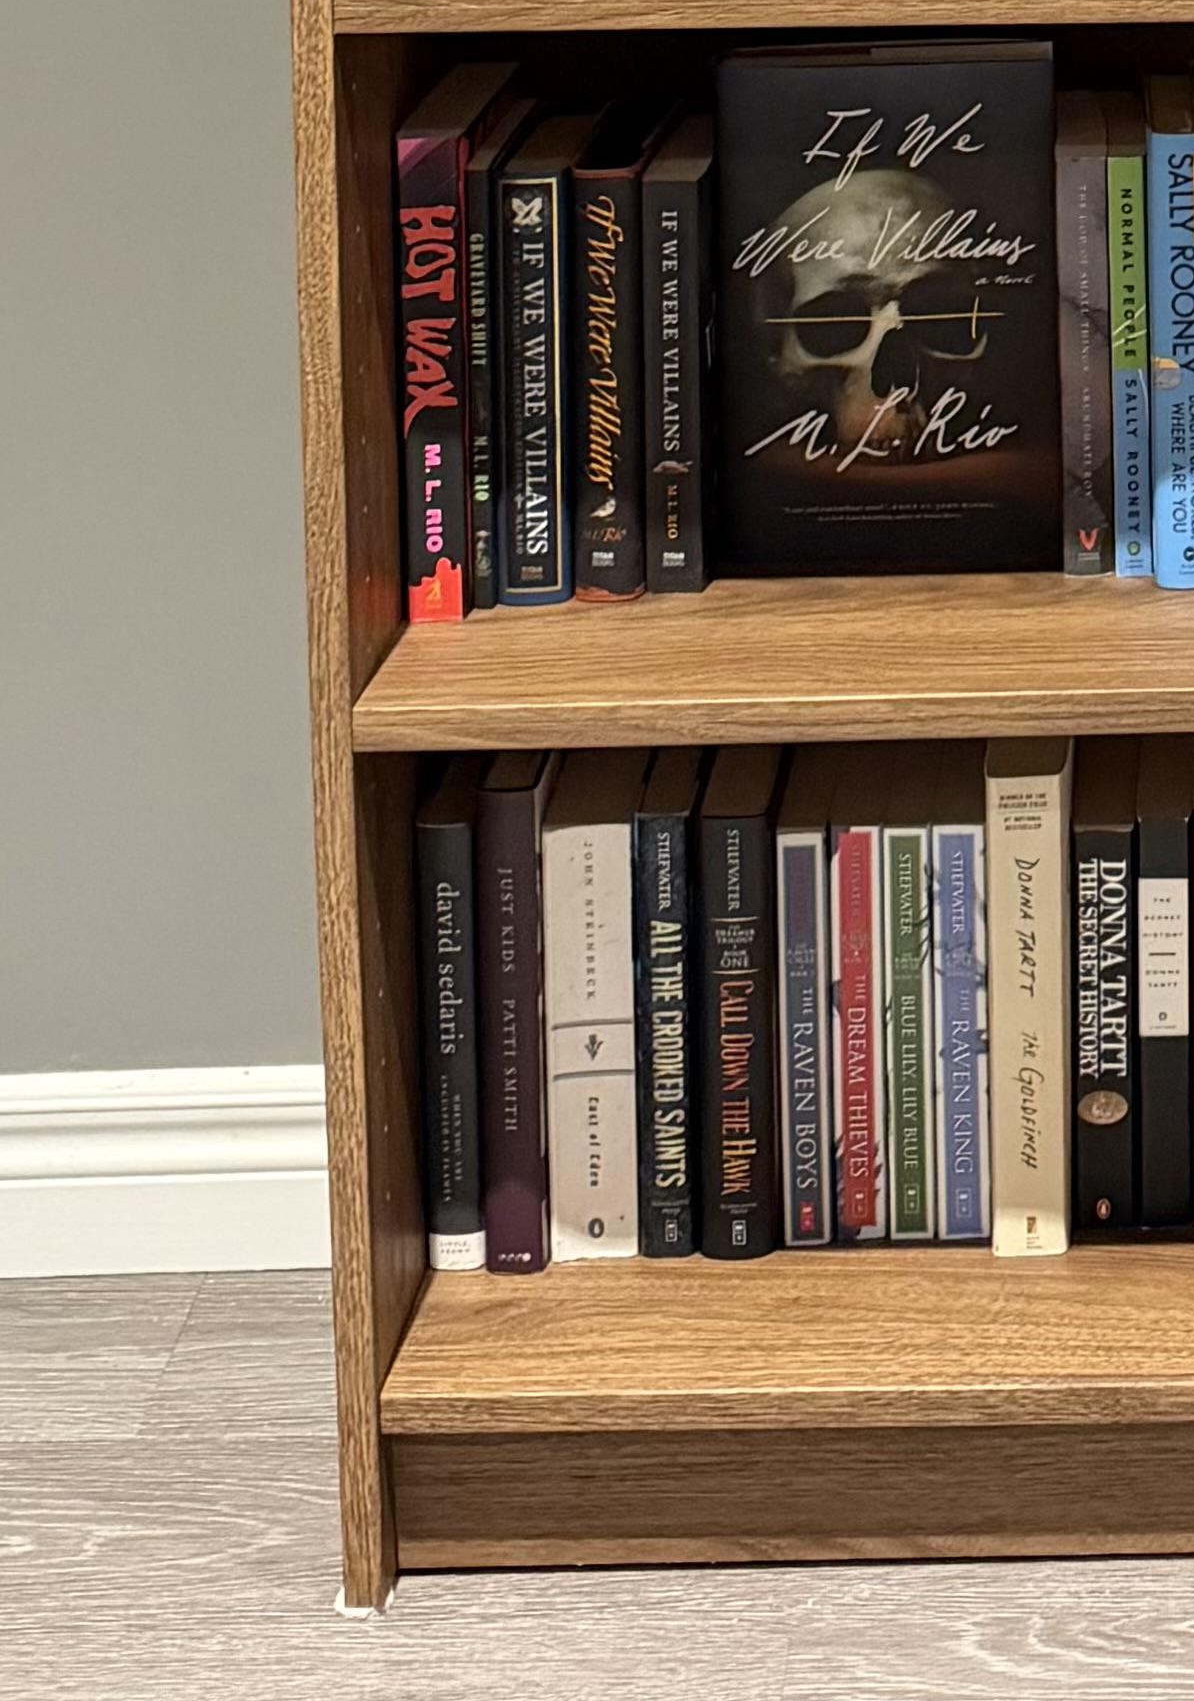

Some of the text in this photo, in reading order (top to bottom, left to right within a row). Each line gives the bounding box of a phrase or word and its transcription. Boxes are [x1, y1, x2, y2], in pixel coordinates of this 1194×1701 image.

[732, 206, 1036, 277] Were Villains
[803, 103, 984, 191] If We
[1168, 153, 1194, 232] SALLY
[401, 205, 458, 439] HOT WAX
[522, 242, 548, 556] IF WE WERE VILLAINS
[436, 883, 463, 1055] david sedaris
[648, 921, 686, 1188] ALL THE CROOKED SAINTS
[1078, 859, 1098, 1079] THE SECRET HISTORY
[1099, 859, 1127, 1077] DONNA TARTT
